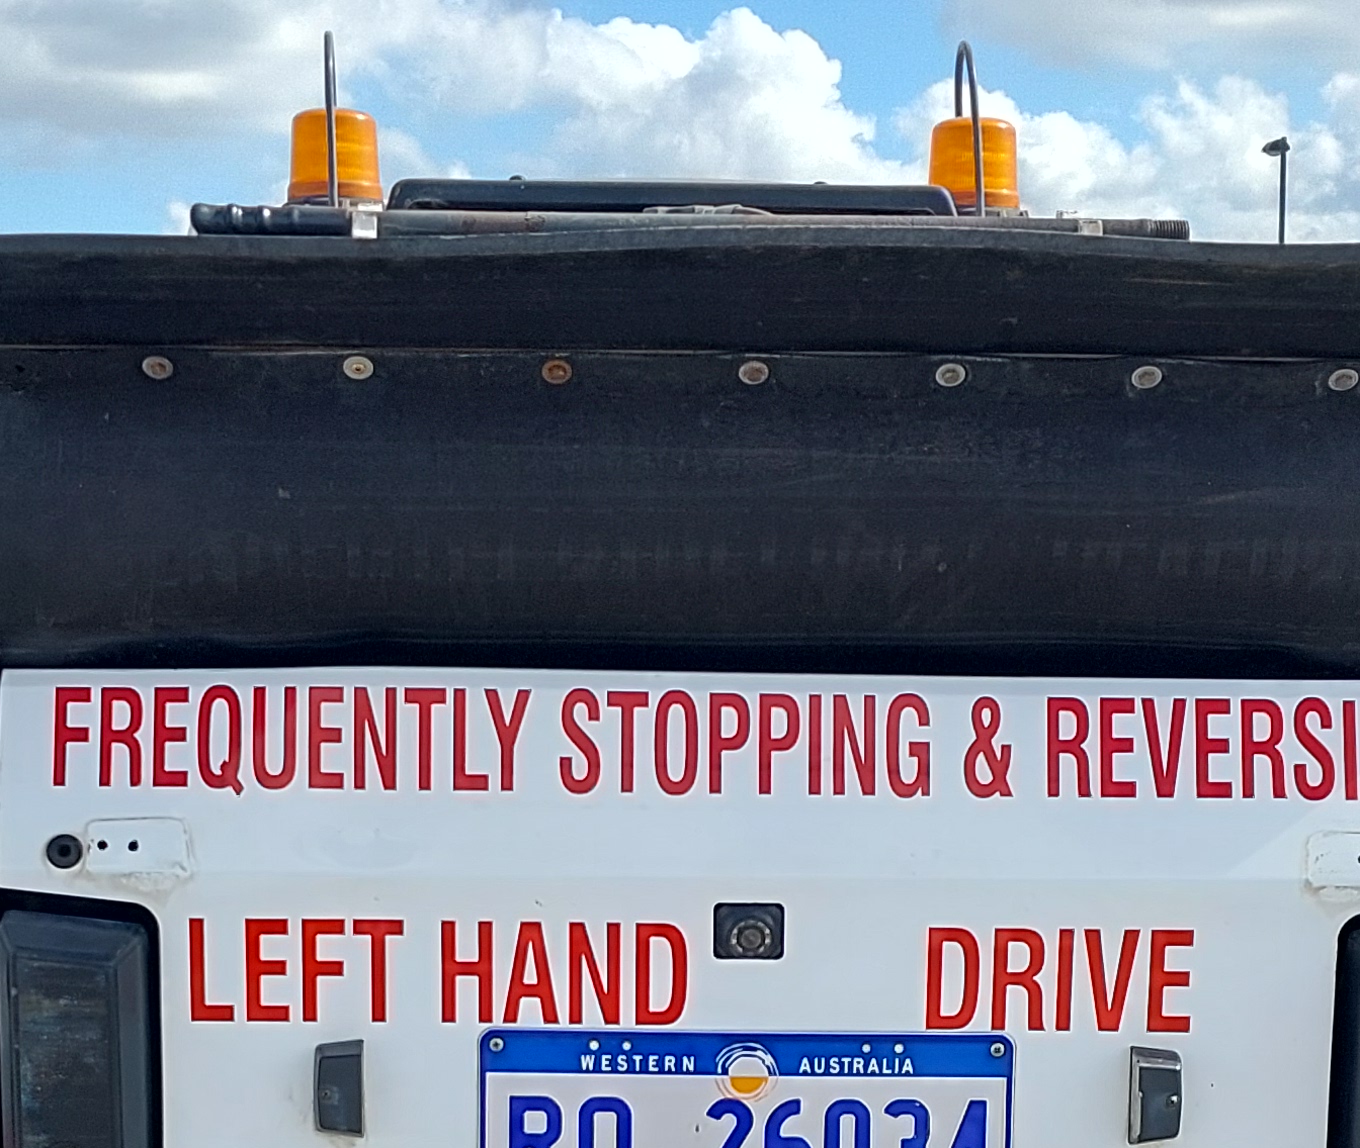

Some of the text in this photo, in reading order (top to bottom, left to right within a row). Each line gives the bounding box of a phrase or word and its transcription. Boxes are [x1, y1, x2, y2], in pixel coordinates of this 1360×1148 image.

[52, 684, 531, 795] FREQUENTLY
[558, 687, 931, 797] STOPPING
[963, 696, 1013, 798] &
[188, 918, 1195, 1033] LEFT HAND DRIVE
[580, 1054, 914, 1075] WESTERN AUSTRALIA
